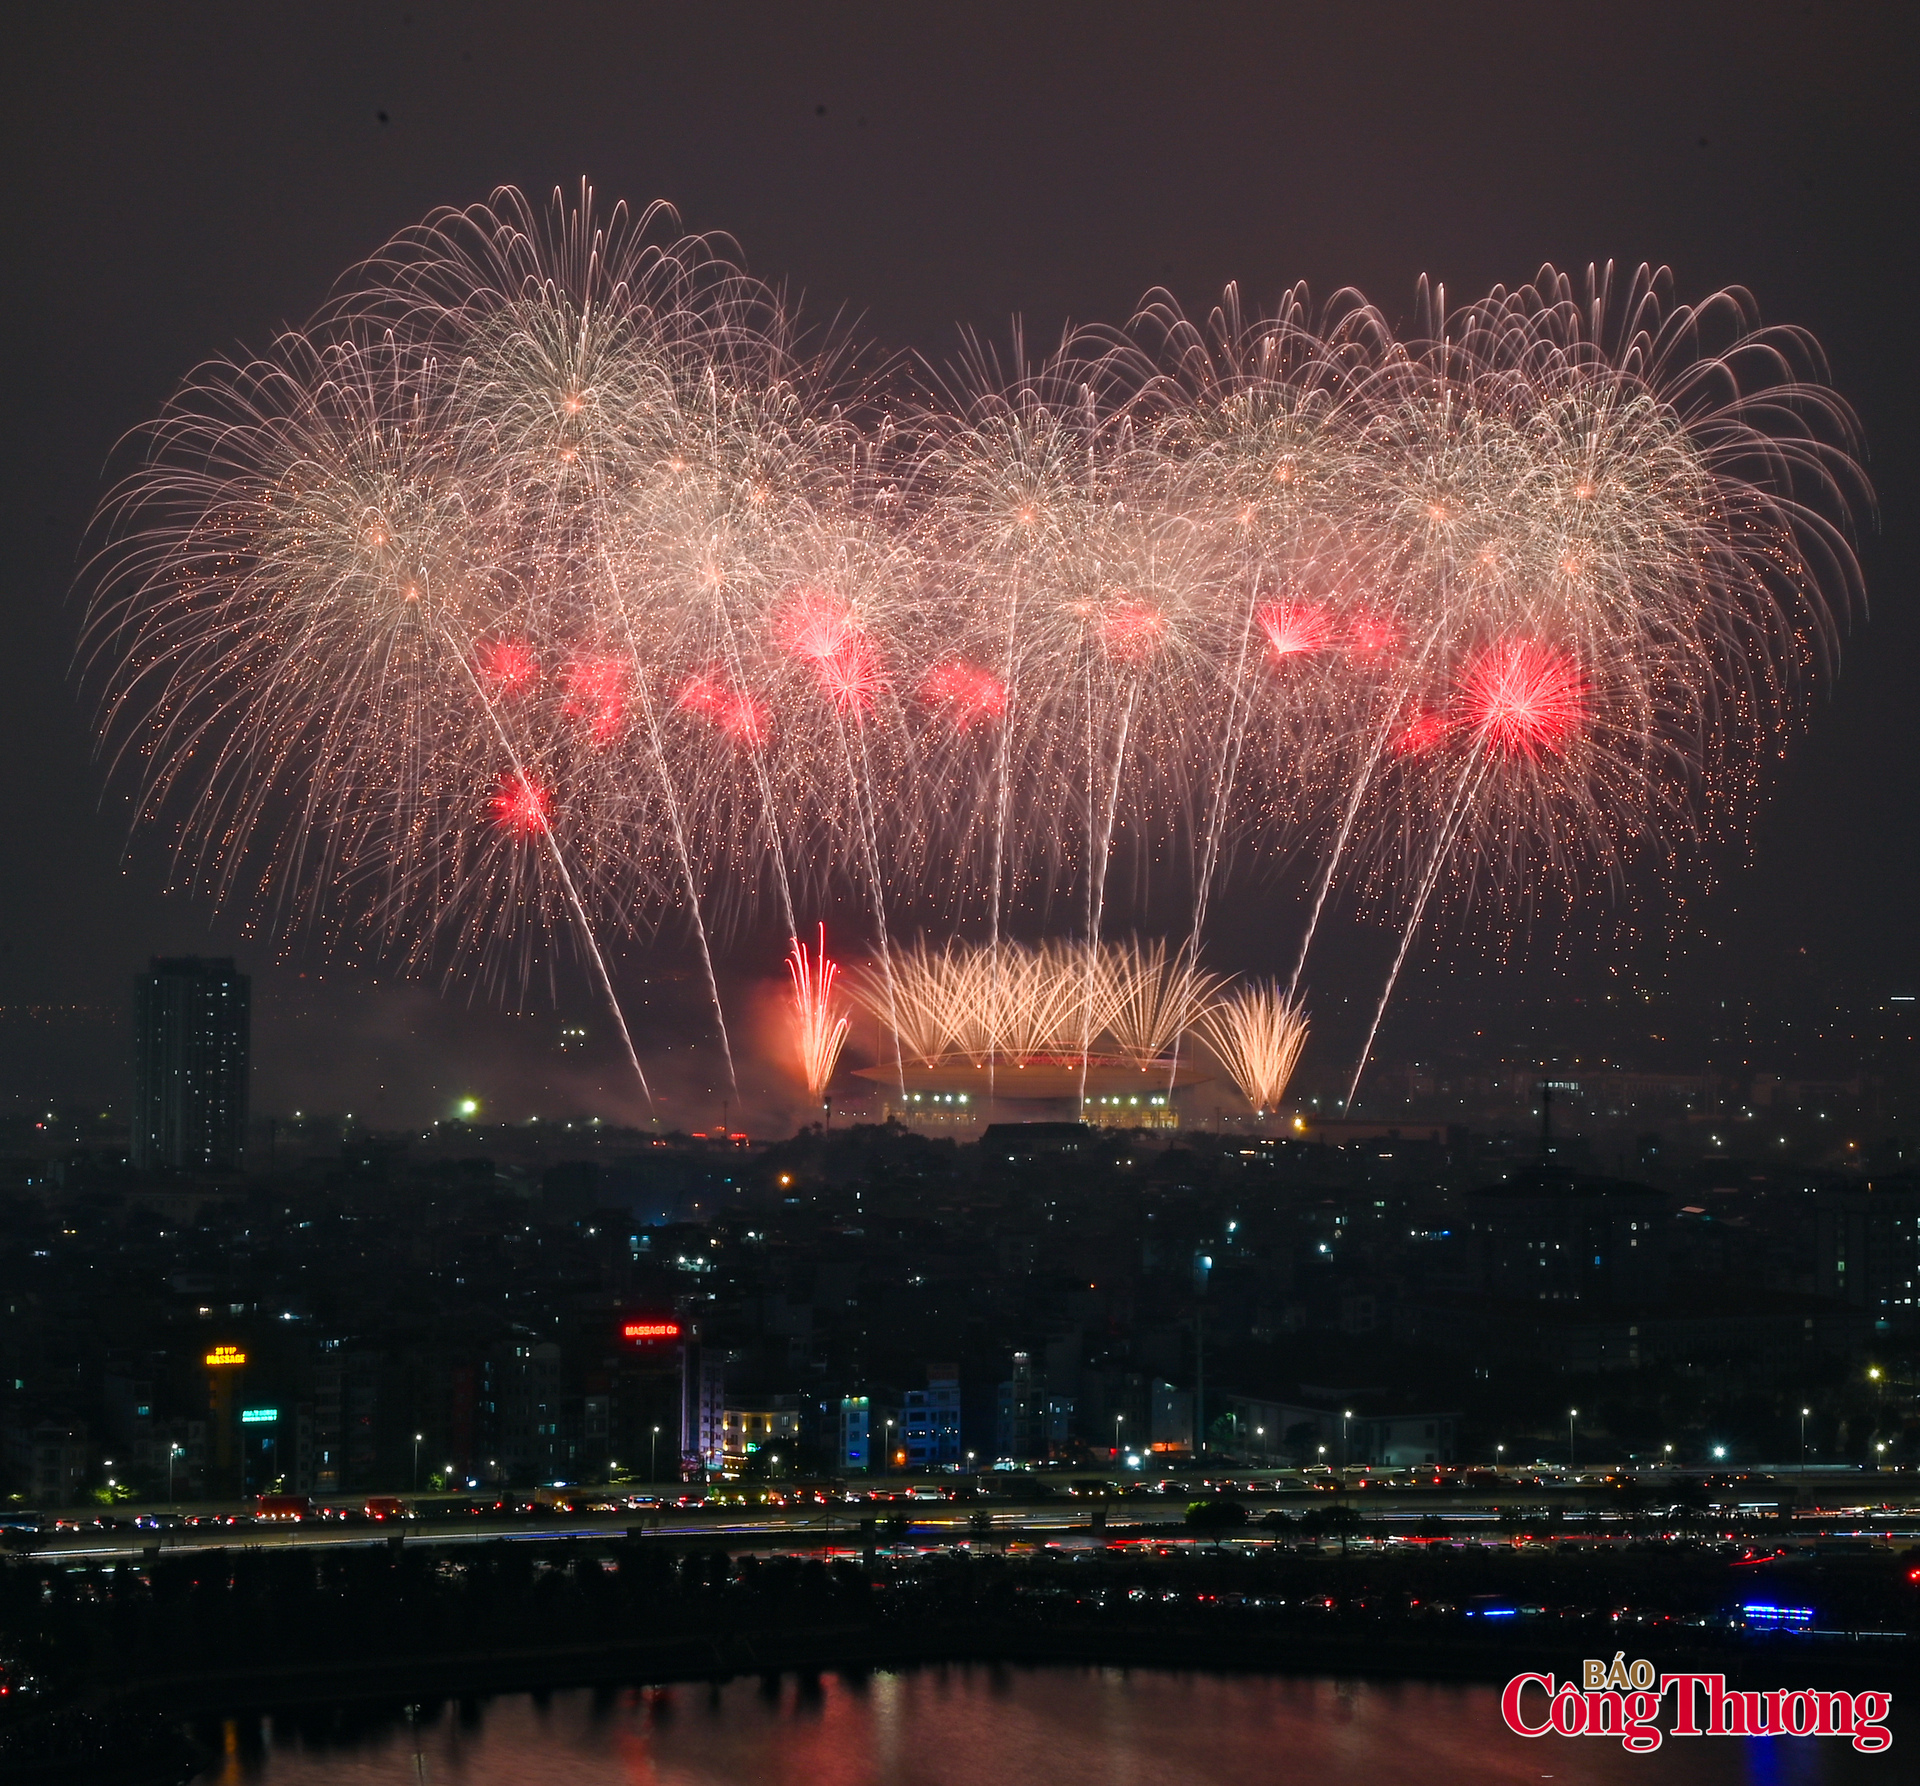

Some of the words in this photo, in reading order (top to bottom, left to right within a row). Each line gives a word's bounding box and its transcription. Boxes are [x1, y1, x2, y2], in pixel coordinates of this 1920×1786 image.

[625, 1325, 666, 1336] MASSAGE
[224, 1346, 237, 1355] VIP
[206, 1354, 246, 1365] MASSAGE
